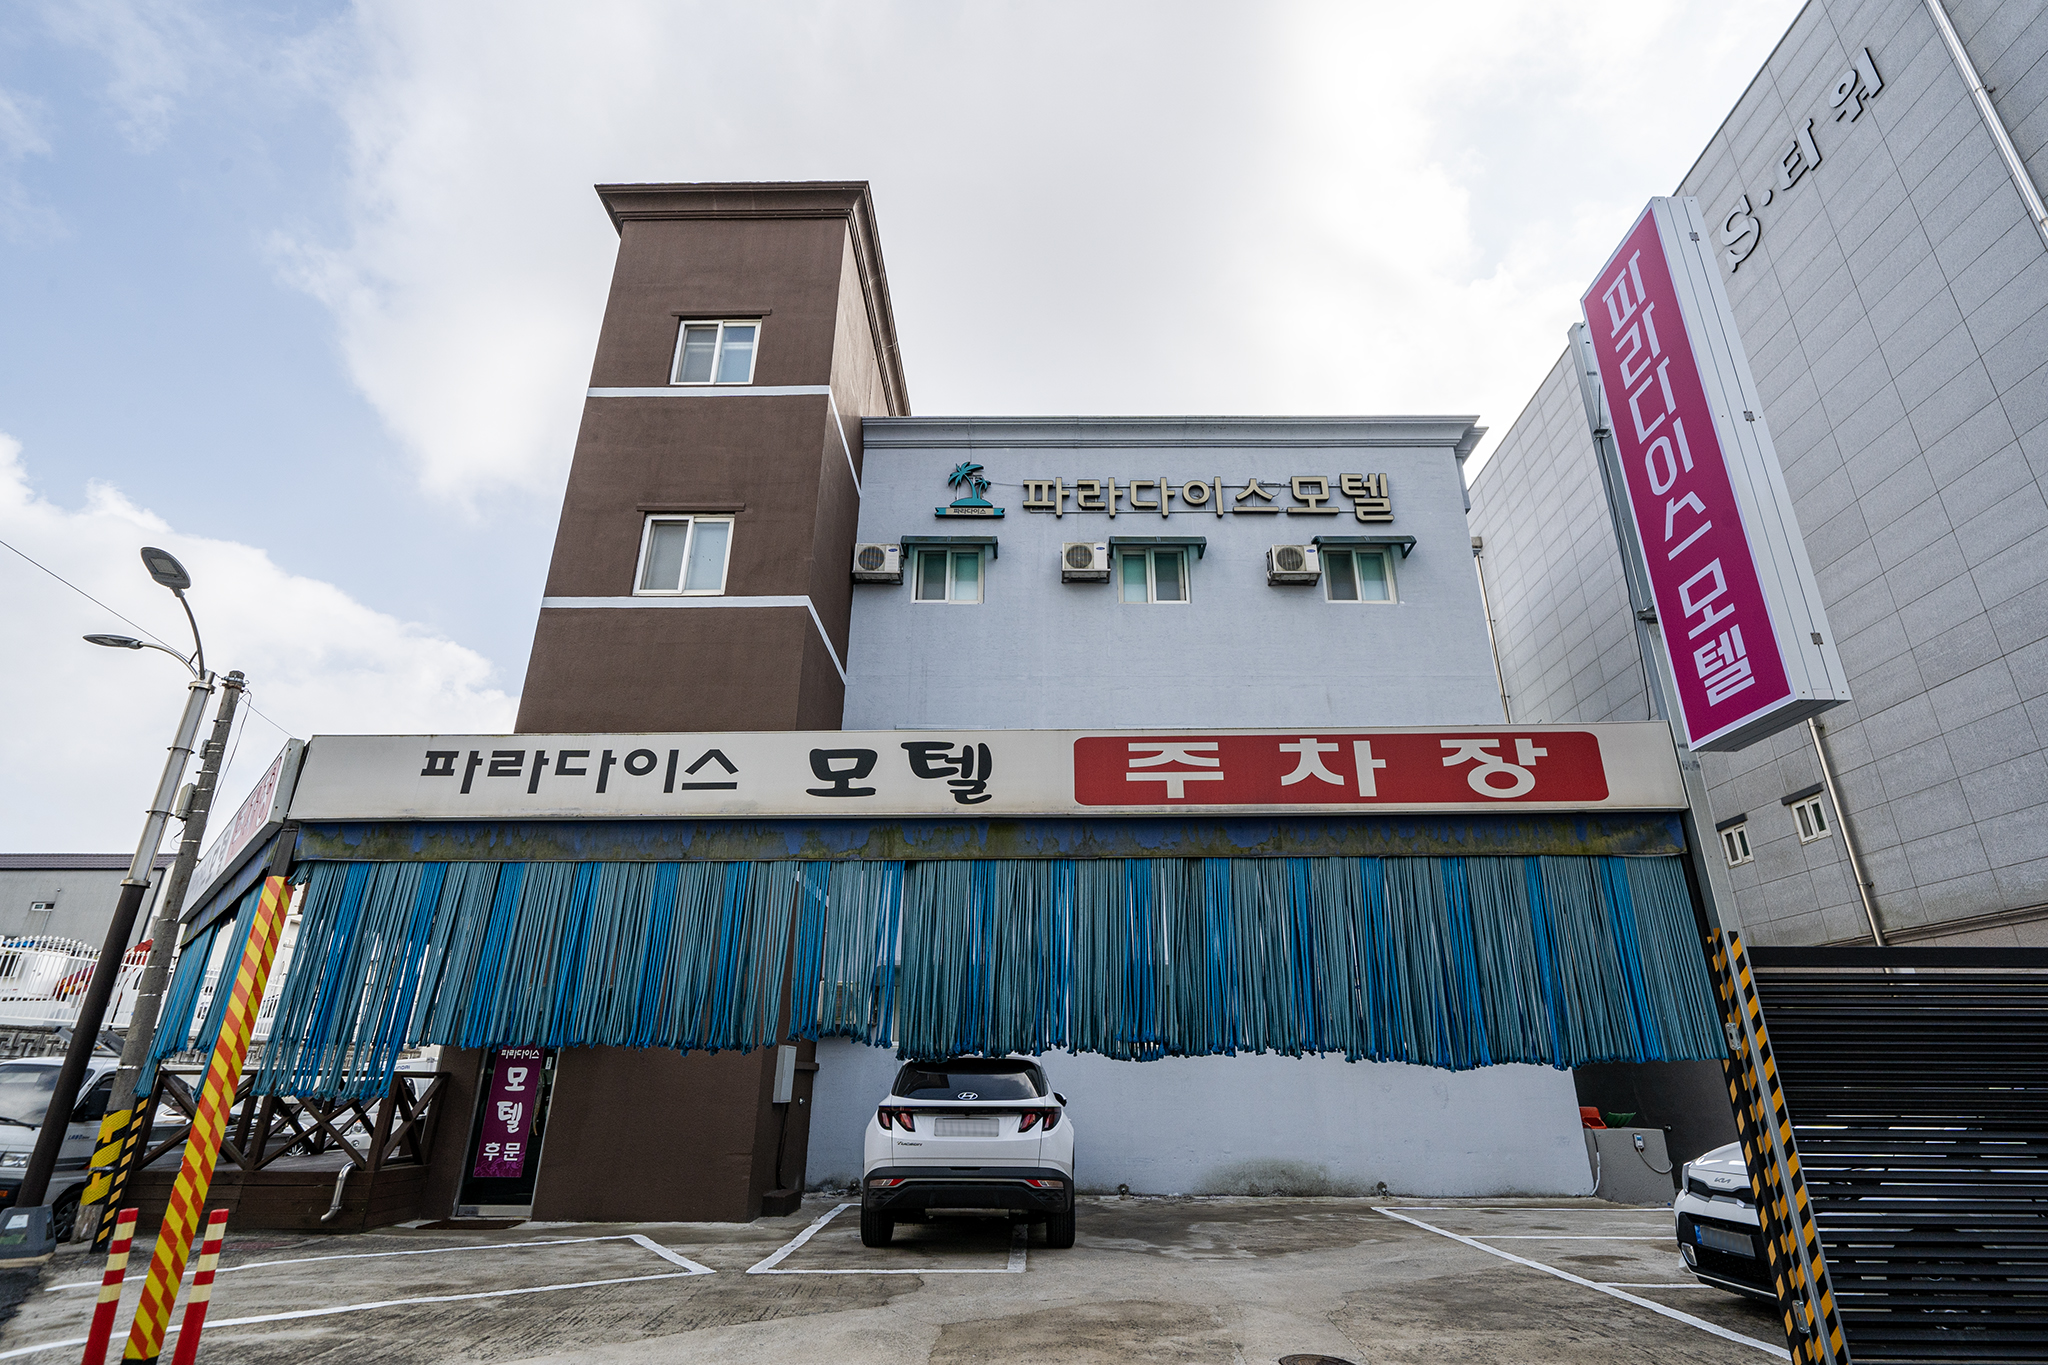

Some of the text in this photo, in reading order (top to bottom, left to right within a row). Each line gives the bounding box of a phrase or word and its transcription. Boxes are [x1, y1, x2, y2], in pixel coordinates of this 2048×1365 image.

[1022, 472, 1396, 523] 파라다이스모텔
[420, 741, 994, 806] 파라다이스 모텔
[1125, 738, 1549, 799] 주차장
[501, 1049, 540, 1060] 파라다이스
[483, 1142, 521, 1162] 후문
